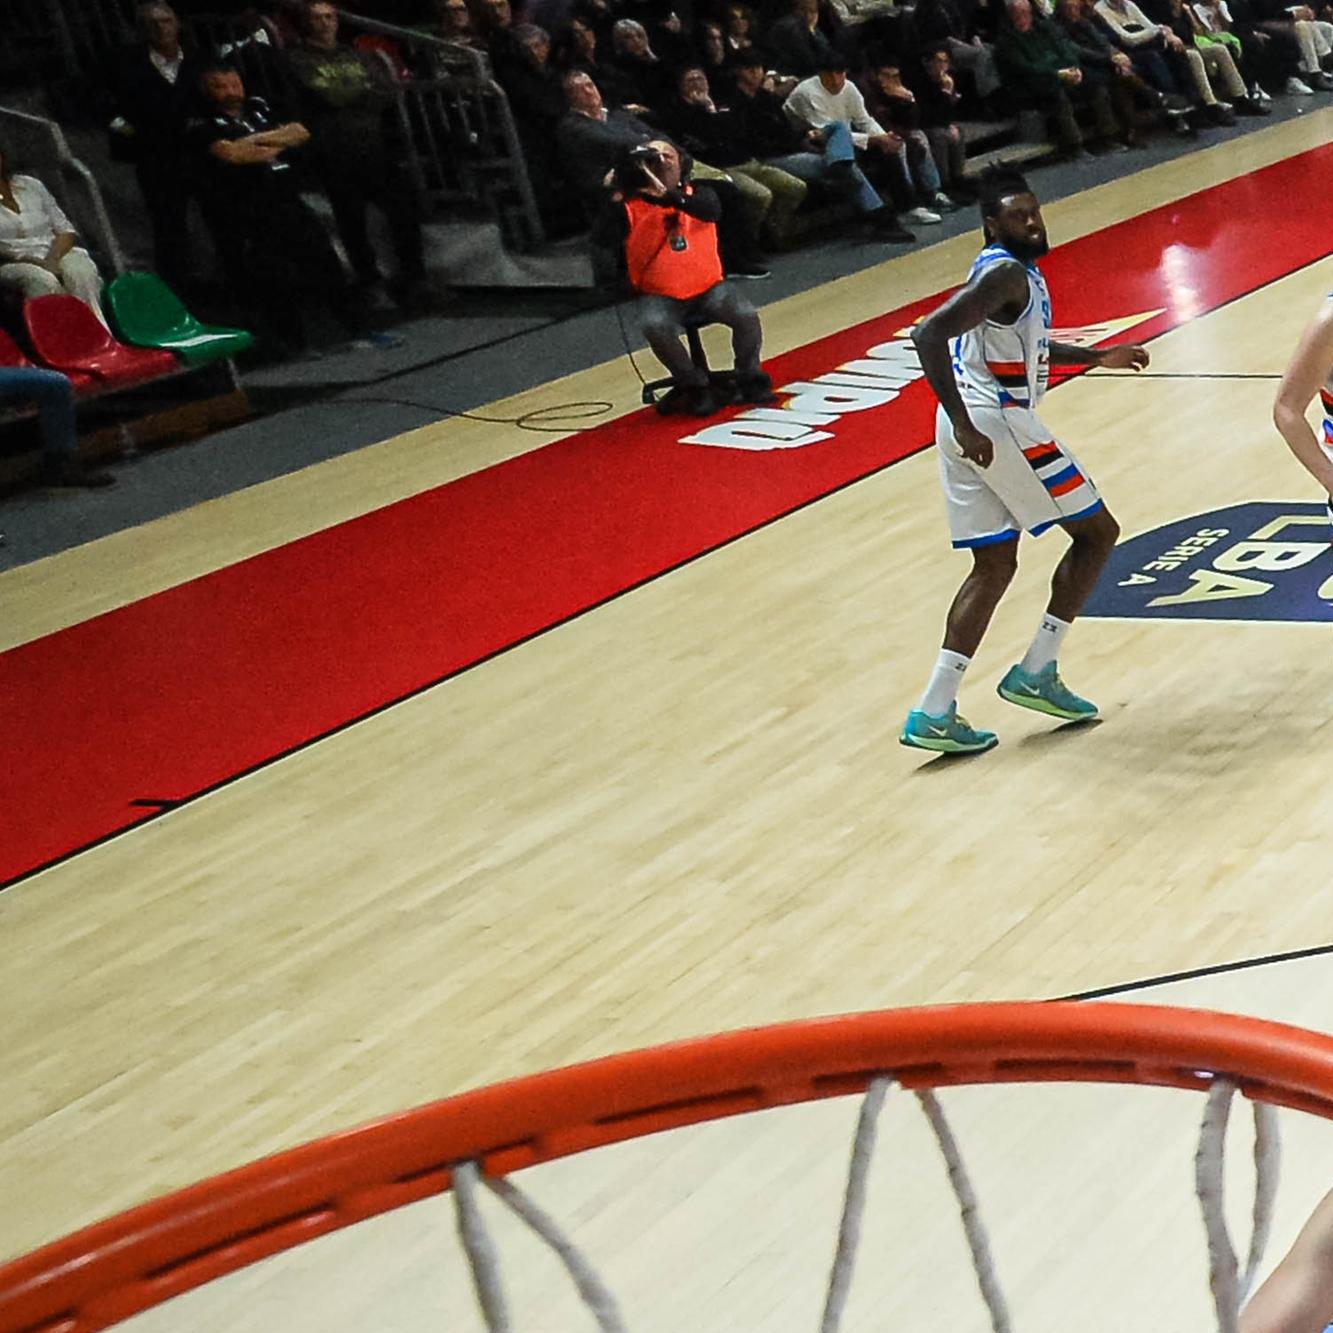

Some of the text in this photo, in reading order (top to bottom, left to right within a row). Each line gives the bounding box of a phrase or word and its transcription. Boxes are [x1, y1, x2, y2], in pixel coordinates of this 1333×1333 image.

[1118, 528, 1226, 588] SERIE A
[1145, 513, 1328, 608] LBA
